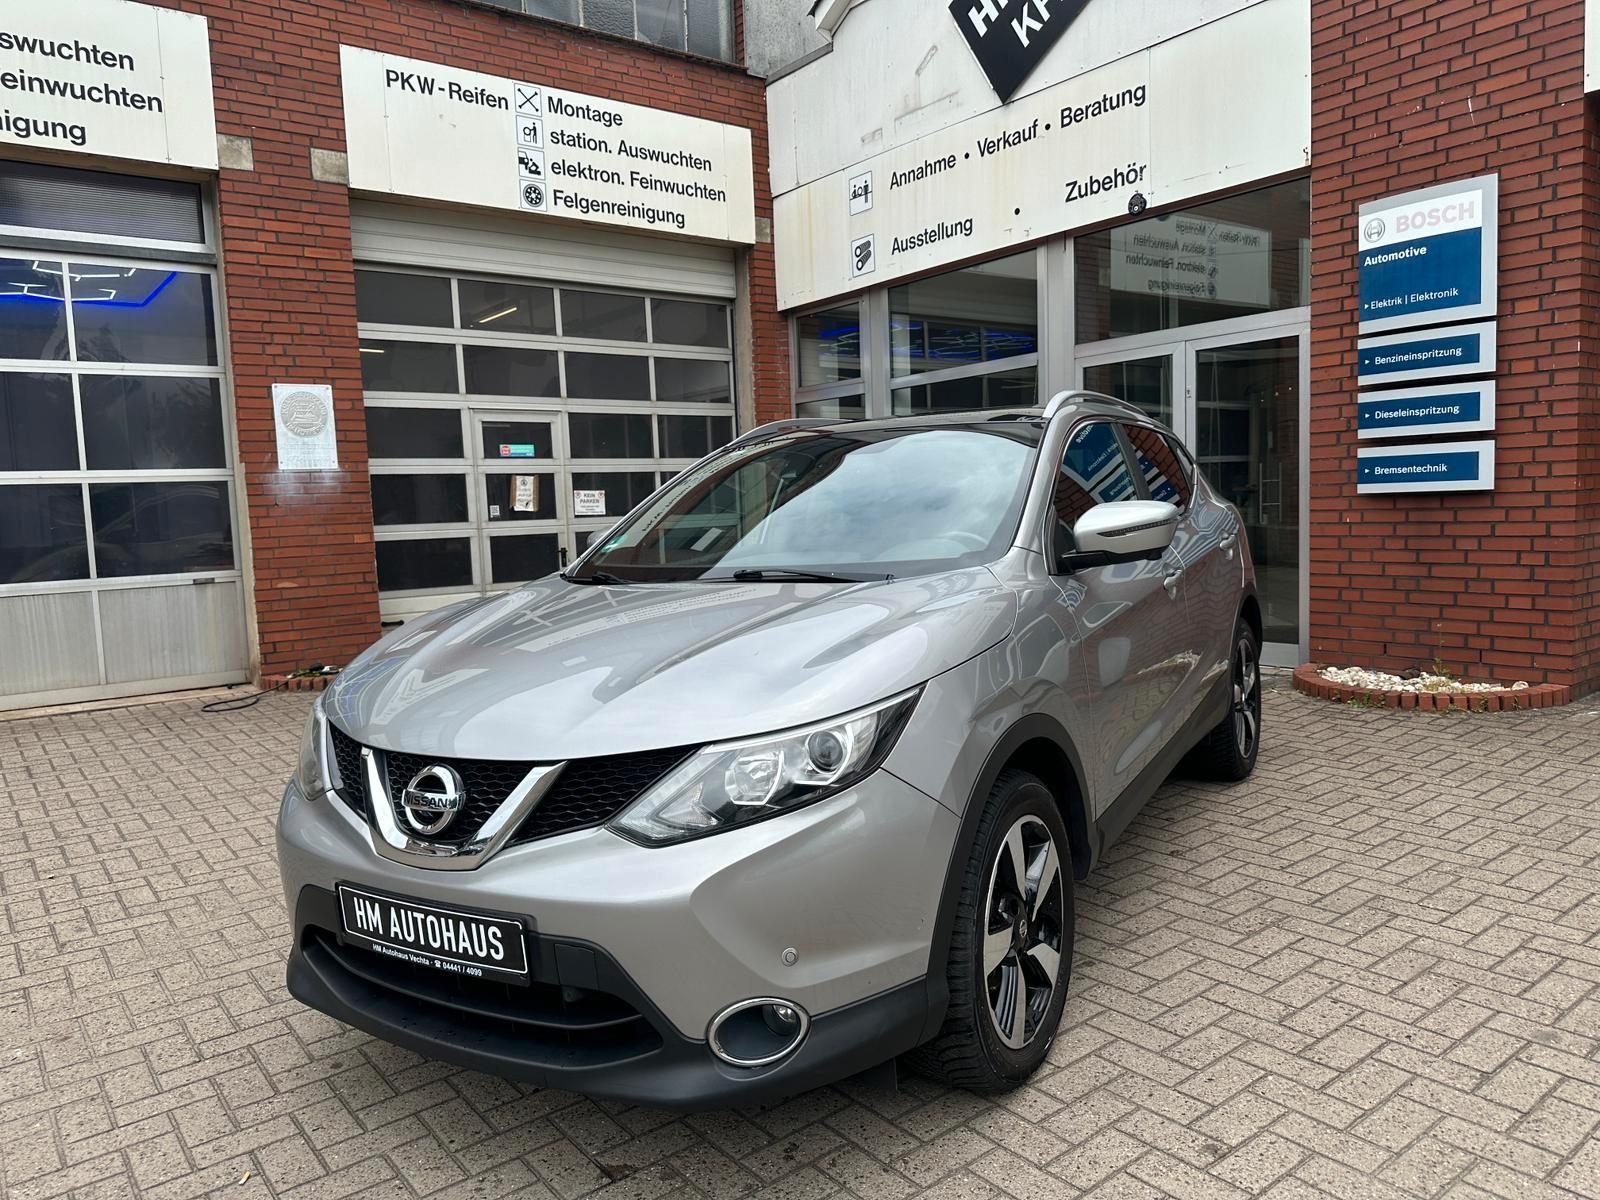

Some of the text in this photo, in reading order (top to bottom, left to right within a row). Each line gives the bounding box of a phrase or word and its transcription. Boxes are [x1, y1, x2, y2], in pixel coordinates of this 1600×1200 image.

[968, 0, 1009, 38] H
[0, 69, 163, 113] einwuchten
[385, 69, 509, 111] PKW-Reifen
[547, 96, 623, 127] Montage
[549, 129, 713, 173] station. Auswuchten
[889, 84, 1147, 190] Annahme Verkauf Beratung
[550, 158, 727, 203] elektron. Feinwuchten
[1065, 161, 1147, 203] Zubehör
[553, 190, 686, 229] Felgenreinigung
[1395, 201, 1475, 234] BOSCH
[891, 216, 974, 256] Ausstellung
[1364, 246, 1427, 266] Automotive
[1370, 295, 1402, 310] Elektrik
[1410, 287, 1459, 303] Elektronik
[1375, 347, 1462, 365] Benzineinspritzung
[1375, 405, 1460, 419] Dieseleinspritzung
[1374, 463, 1448, 475] Bremsentechnik
[405, 792, 448, 808] NISSAN
[353, 896, 505, 960] HM AUTOHAUS
[372, 943, 382, 953] HM
[382, 945, 409, 961] Autohaus
[410, 952, 430, 966] Vechta
[442, 961, 461, 972] 04441
[466, 966, 483, 977] 4099
